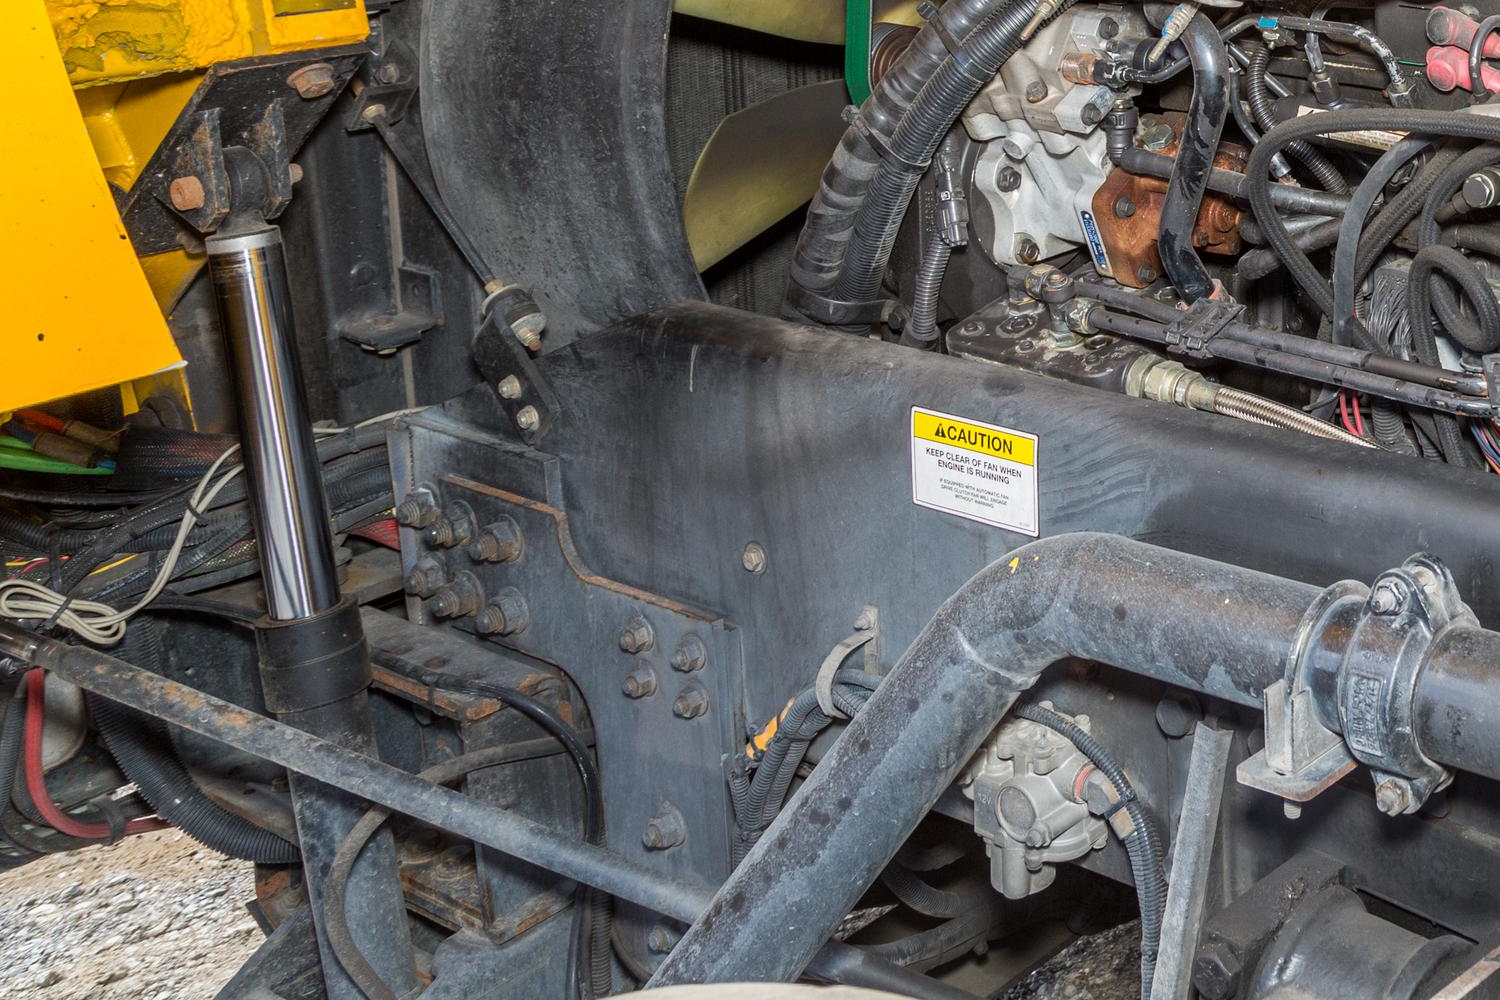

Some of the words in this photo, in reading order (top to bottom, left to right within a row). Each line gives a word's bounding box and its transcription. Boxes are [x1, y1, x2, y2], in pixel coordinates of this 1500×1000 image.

[947, 425, 1013, 455] CAUTION
[926, 447, 944, 458] KEEP
[945, 452, 970, 465] CLEAR
[971, 458, 982, 467] OF
[983, 461, 998, 472] FAN
[1000, 466, 1022, 478] WHEN
[938, 460, 965, 473] ENGINE
[966, 467, 974, 476] IS
[975, 469, 1010, 485] RUNNING
